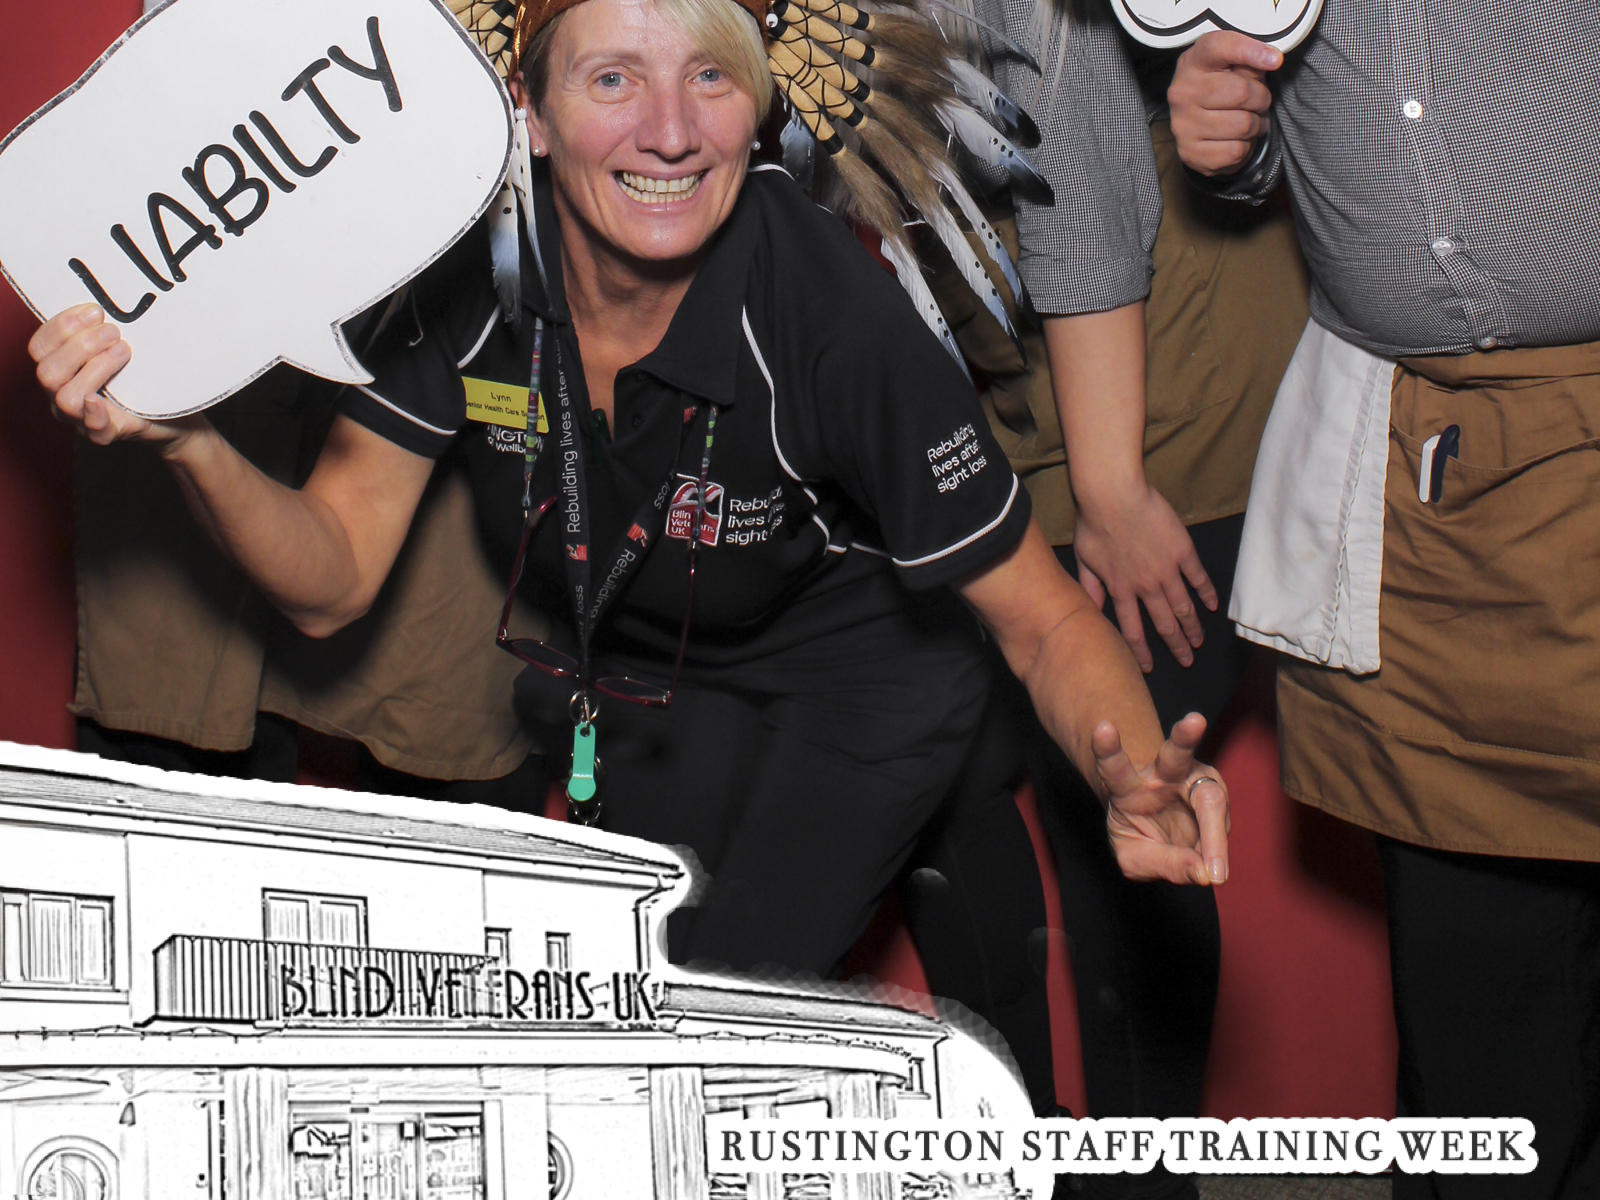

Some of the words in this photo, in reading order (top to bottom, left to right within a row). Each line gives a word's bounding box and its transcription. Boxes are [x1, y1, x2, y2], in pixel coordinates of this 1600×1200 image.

[68, 16, 403, 323] LIABILTY
[490, 391, 512, 402] Lynn
[558, 369, 570, 407] after
[466, 401, 482, 410] enior
[484, 404, 504, 413] Health
[505, 407, 520, 416] Care
[560, 411, 573, 447] lives
[932, 455, 960, 477] lives
[937, 467, 970, 493] sight
[562, 450, 581, 533] Rebuilding
[653, 481, 671, 509] loss
[672, 509, 691, 520] Blin
[727, 515, 765, 528] lives
[671, 526, 685, 535] UK
[726, 529, 768, 546] sight
